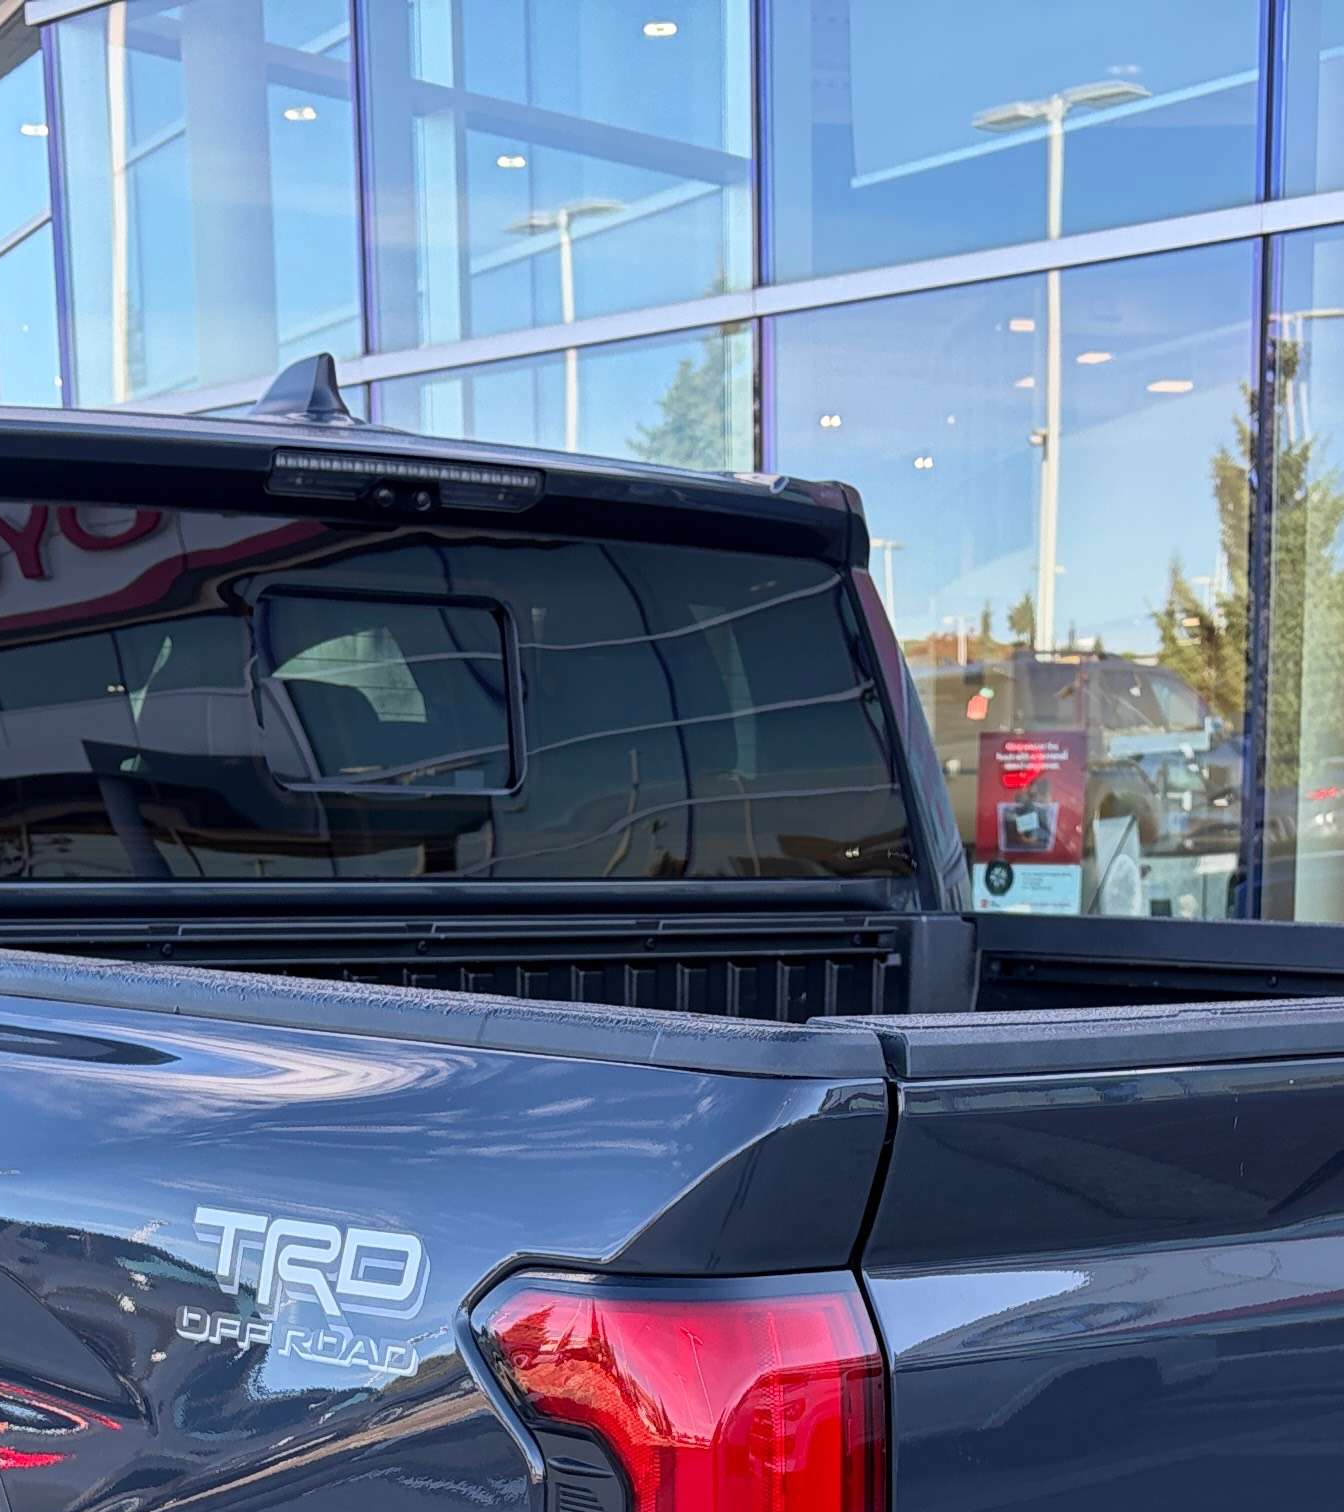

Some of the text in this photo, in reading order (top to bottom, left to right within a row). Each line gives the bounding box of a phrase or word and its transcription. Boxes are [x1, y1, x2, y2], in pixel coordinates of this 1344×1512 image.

[193, 1205, 431, 1320] TRD
[175, 1305, 419, 1378] OFF ROAD
